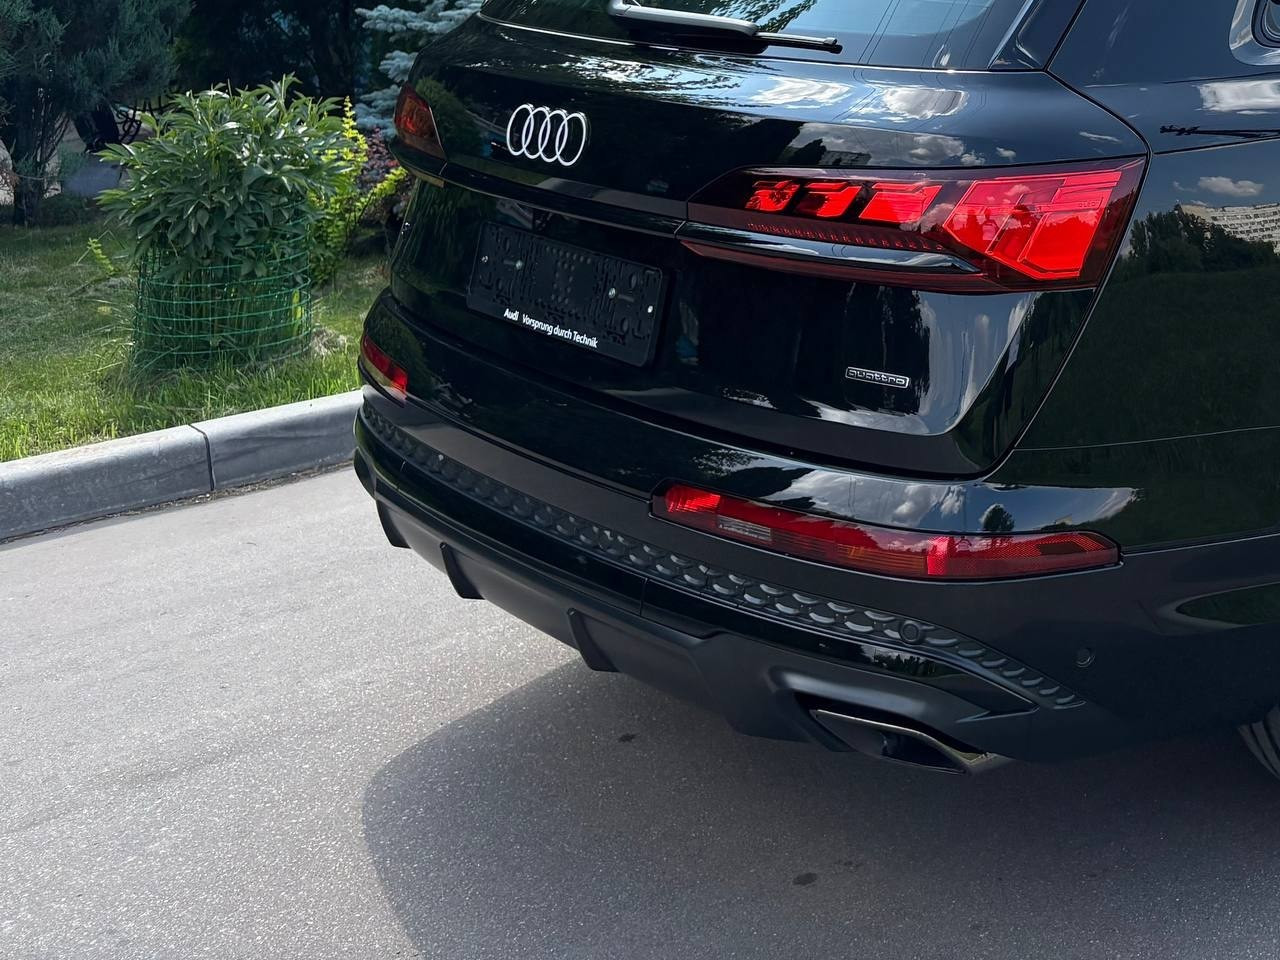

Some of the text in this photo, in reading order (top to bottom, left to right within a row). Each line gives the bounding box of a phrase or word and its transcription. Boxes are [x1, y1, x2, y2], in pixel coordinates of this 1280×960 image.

[504, 308, 598, 348] Audi Vorsprung durch Technik
[848, 369, 906, 385] quattro
